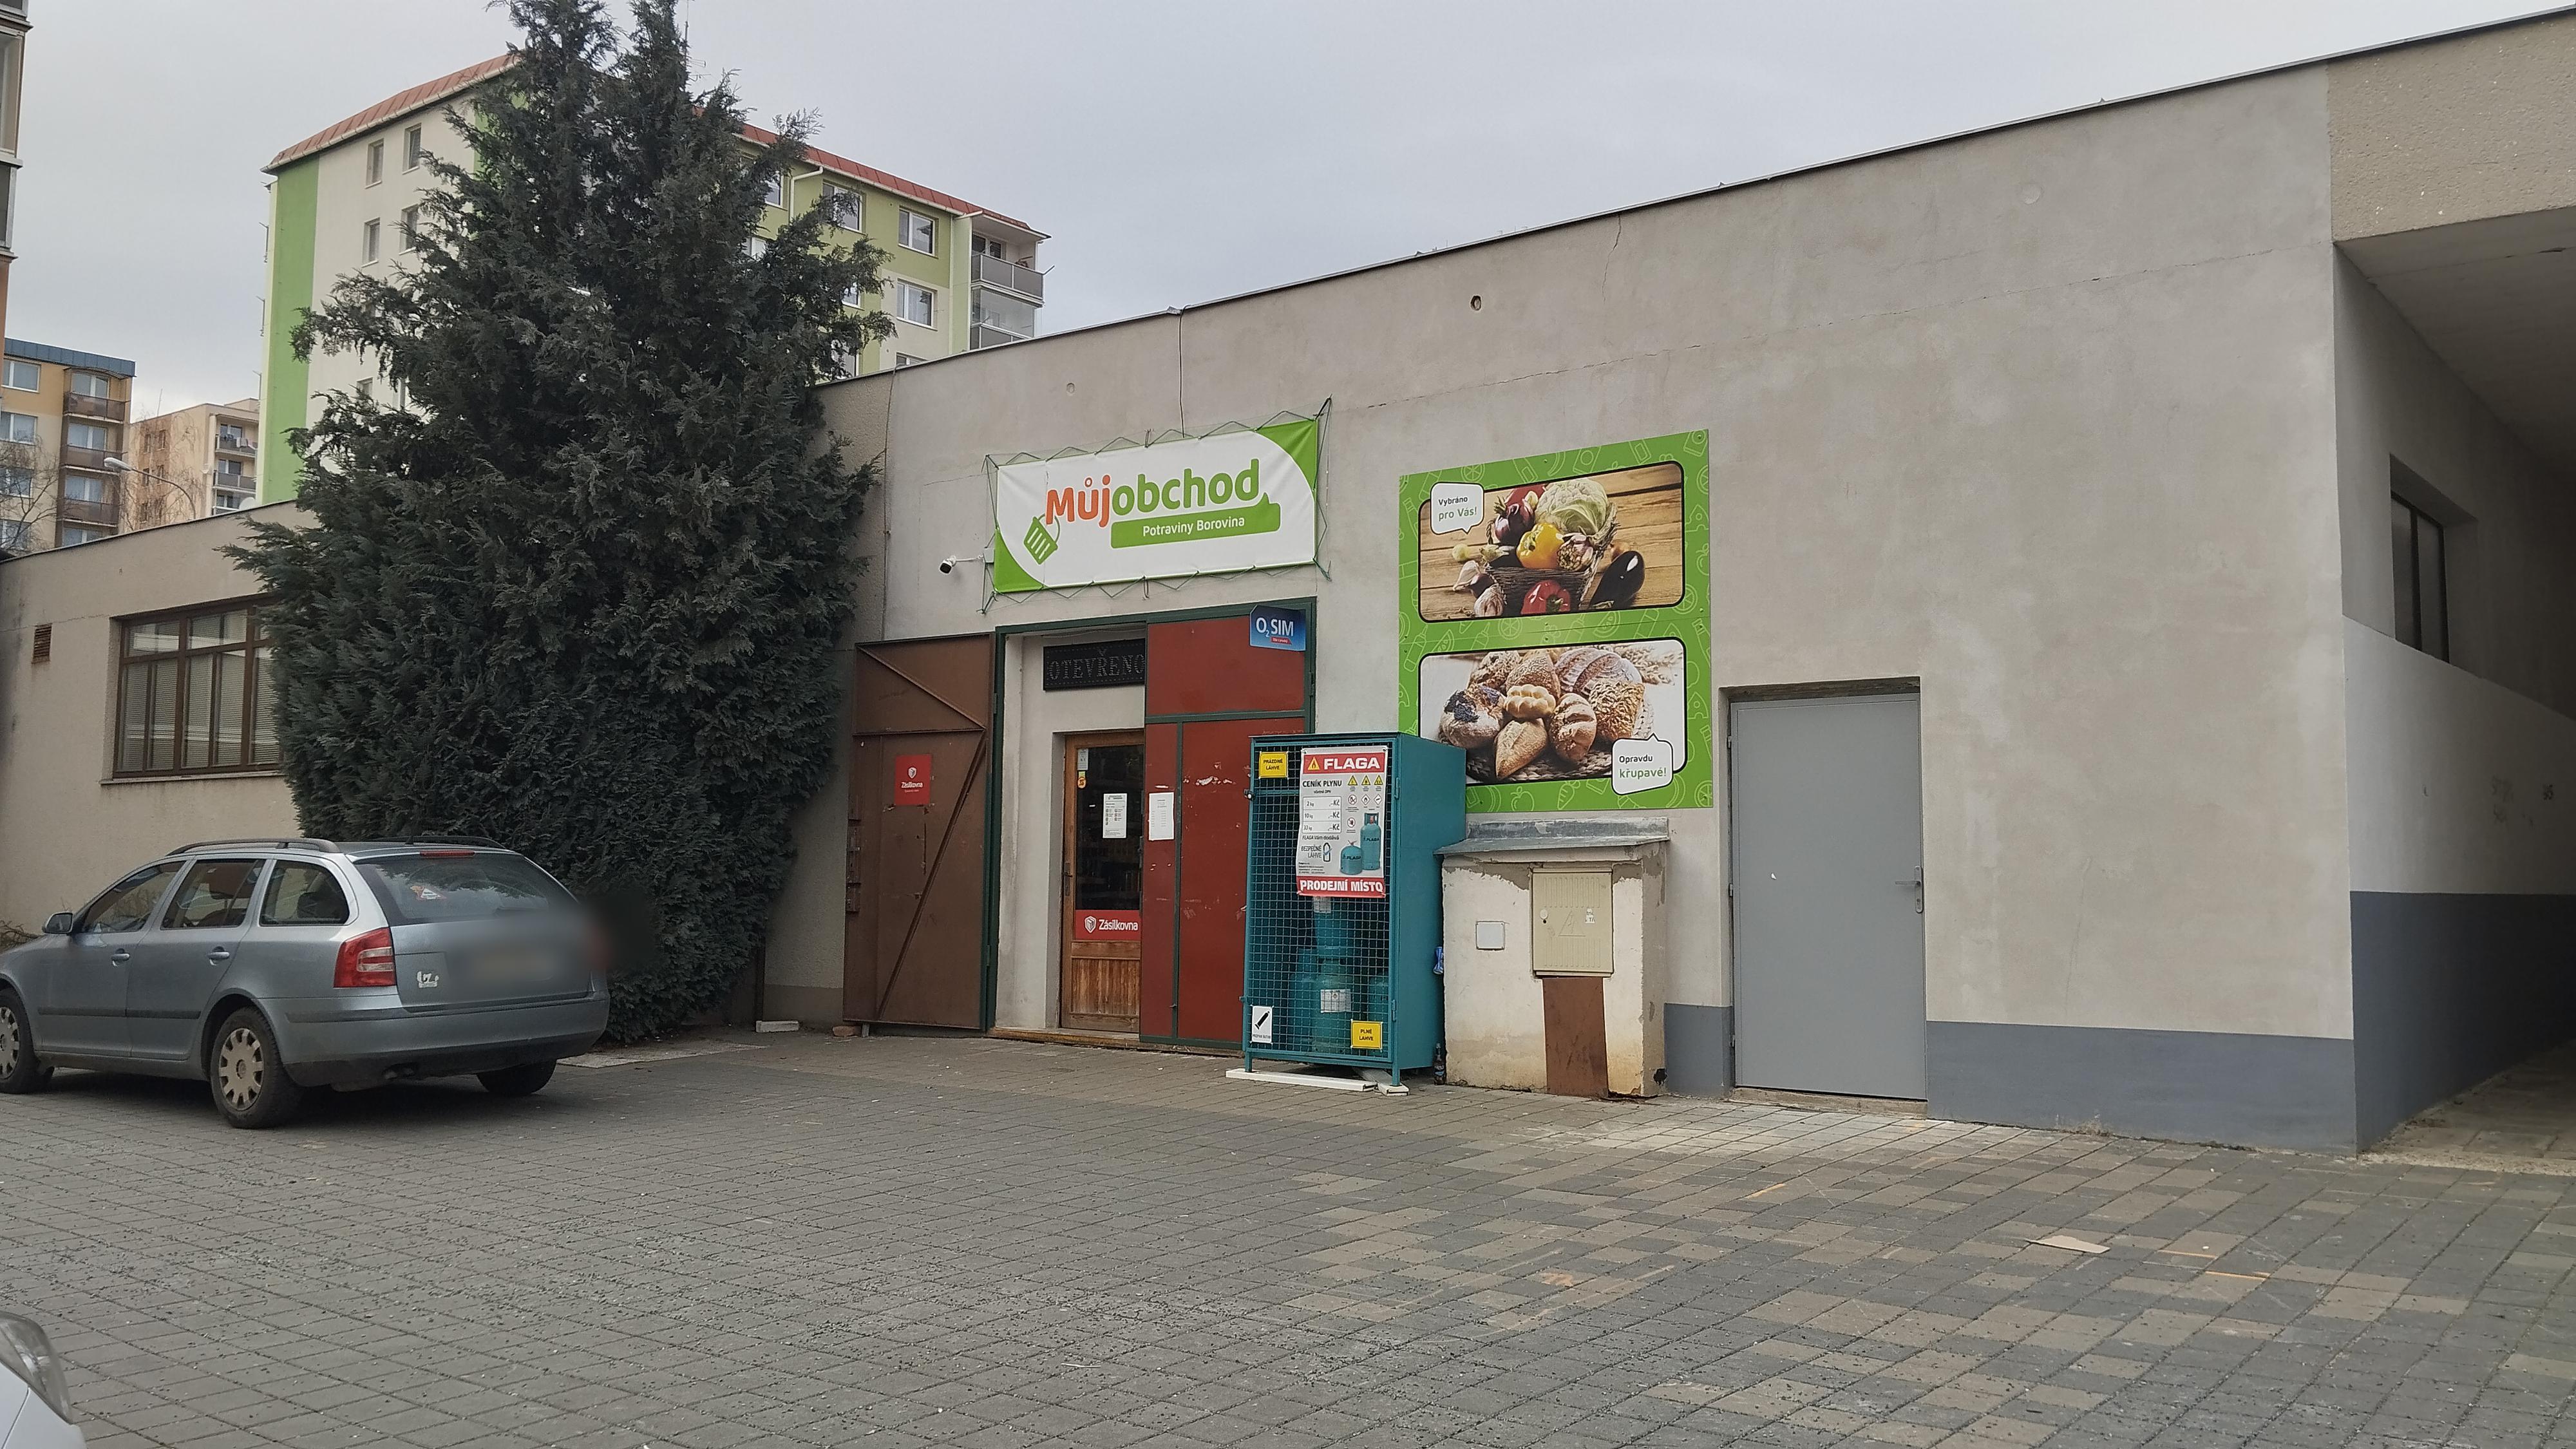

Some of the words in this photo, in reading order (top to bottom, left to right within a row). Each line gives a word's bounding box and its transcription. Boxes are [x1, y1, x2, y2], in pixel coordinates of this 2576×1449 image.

[1438, 496, 1468, 506] Vybráno
[1438, 509, 1455, 522] pro
[1457, 506, 1477, 517] Vás!
[1142, 523, 1193, 537] Potraviny
[1197, 516, 1245, 531] Borovina
[1271, 618, 1294, 637] SIM
[1048, 649, 1146, 680] OTEVŘENO
[1323, 757, 1381, 770] FLAGA
[1619, 754, 1653, 764] Opravdu
[1619, 767, 1667, 779] křupavé!
[1302, 779, 1321, 788] CENÍK
[1300, 878, 1349, 892] PRODEJNÍ
[1350, 879, 1383, 893] MÍSTO
[1099, 919, 1139, 931] Zásilkovna
